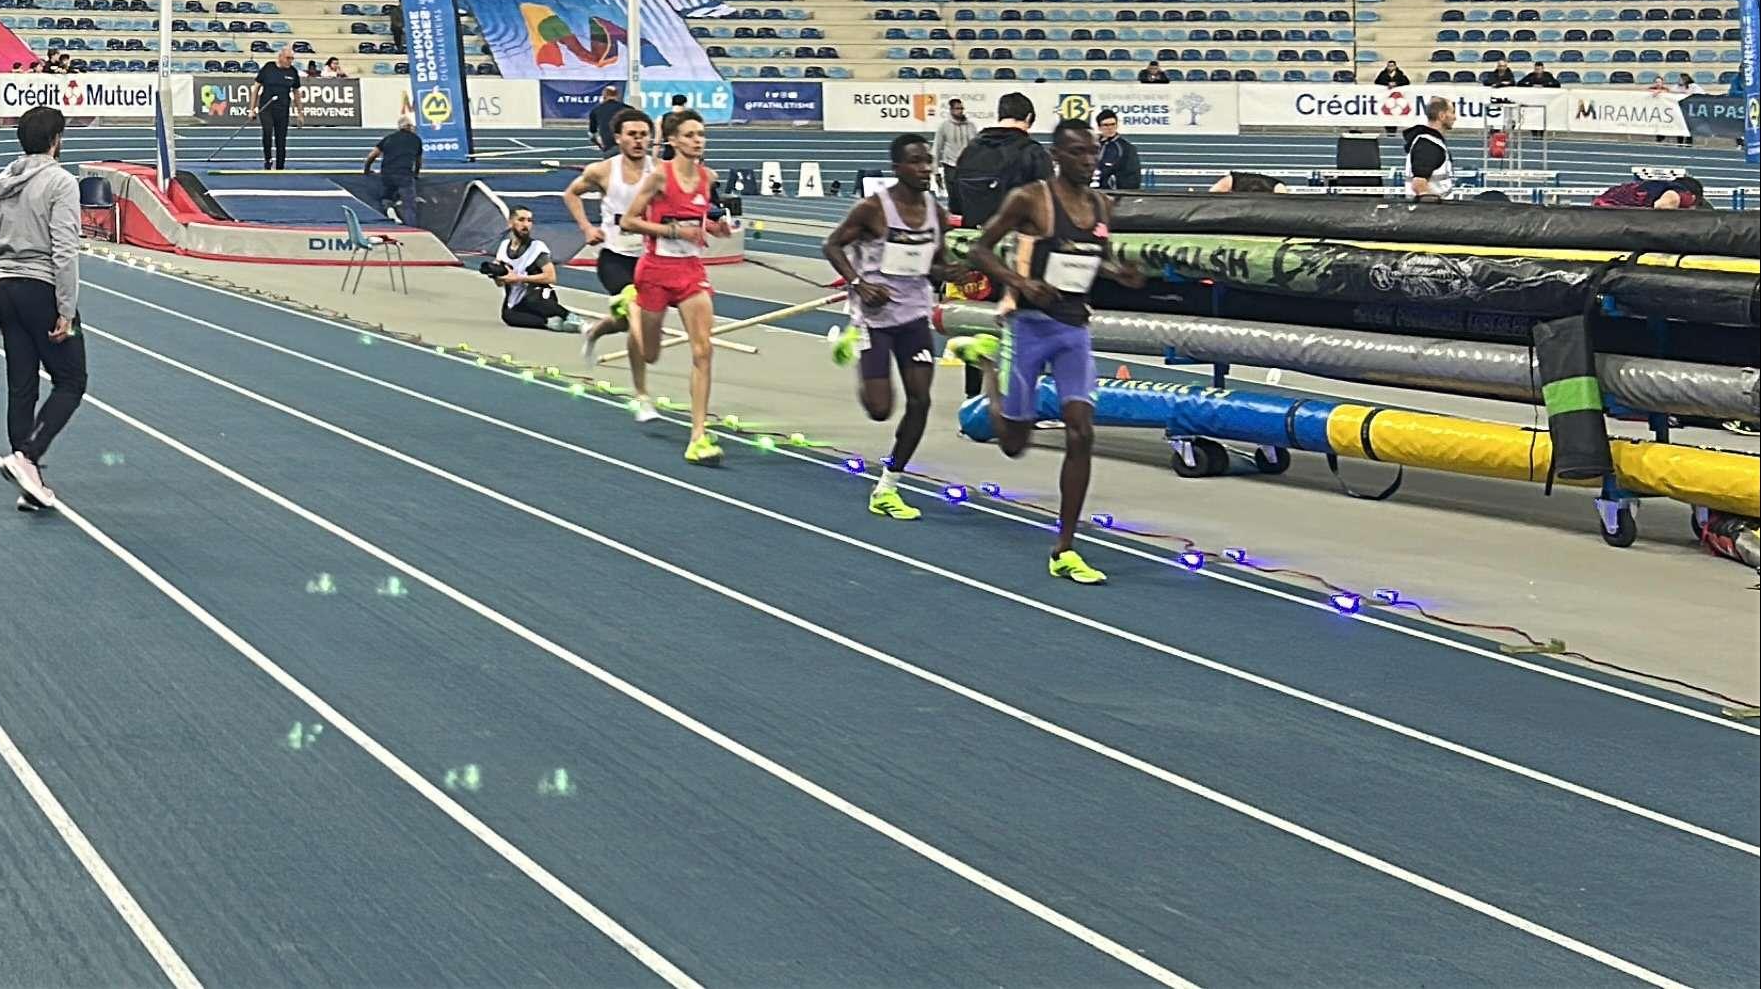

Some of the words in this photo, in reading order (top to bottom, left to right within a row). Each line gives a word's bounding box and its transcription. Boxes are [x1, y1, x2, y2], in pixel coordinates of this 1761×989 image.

[4, 82, 60, 106] Crédit
[86, 84, 153, 106] Mutuel
[854, 94, 910, 105] REGION
[1295, 93, 1377, 116] Crédit
[1576, 99, 1675, 124] MIRAMAS
[1689, 104, 1707, 118] LA
[880, 108, 910, 118] SUD
[1123, 115, 1170, 126] RHÔNE
[806, 174, 815, 189] 4
[308, 237, 360, 251] DIM
